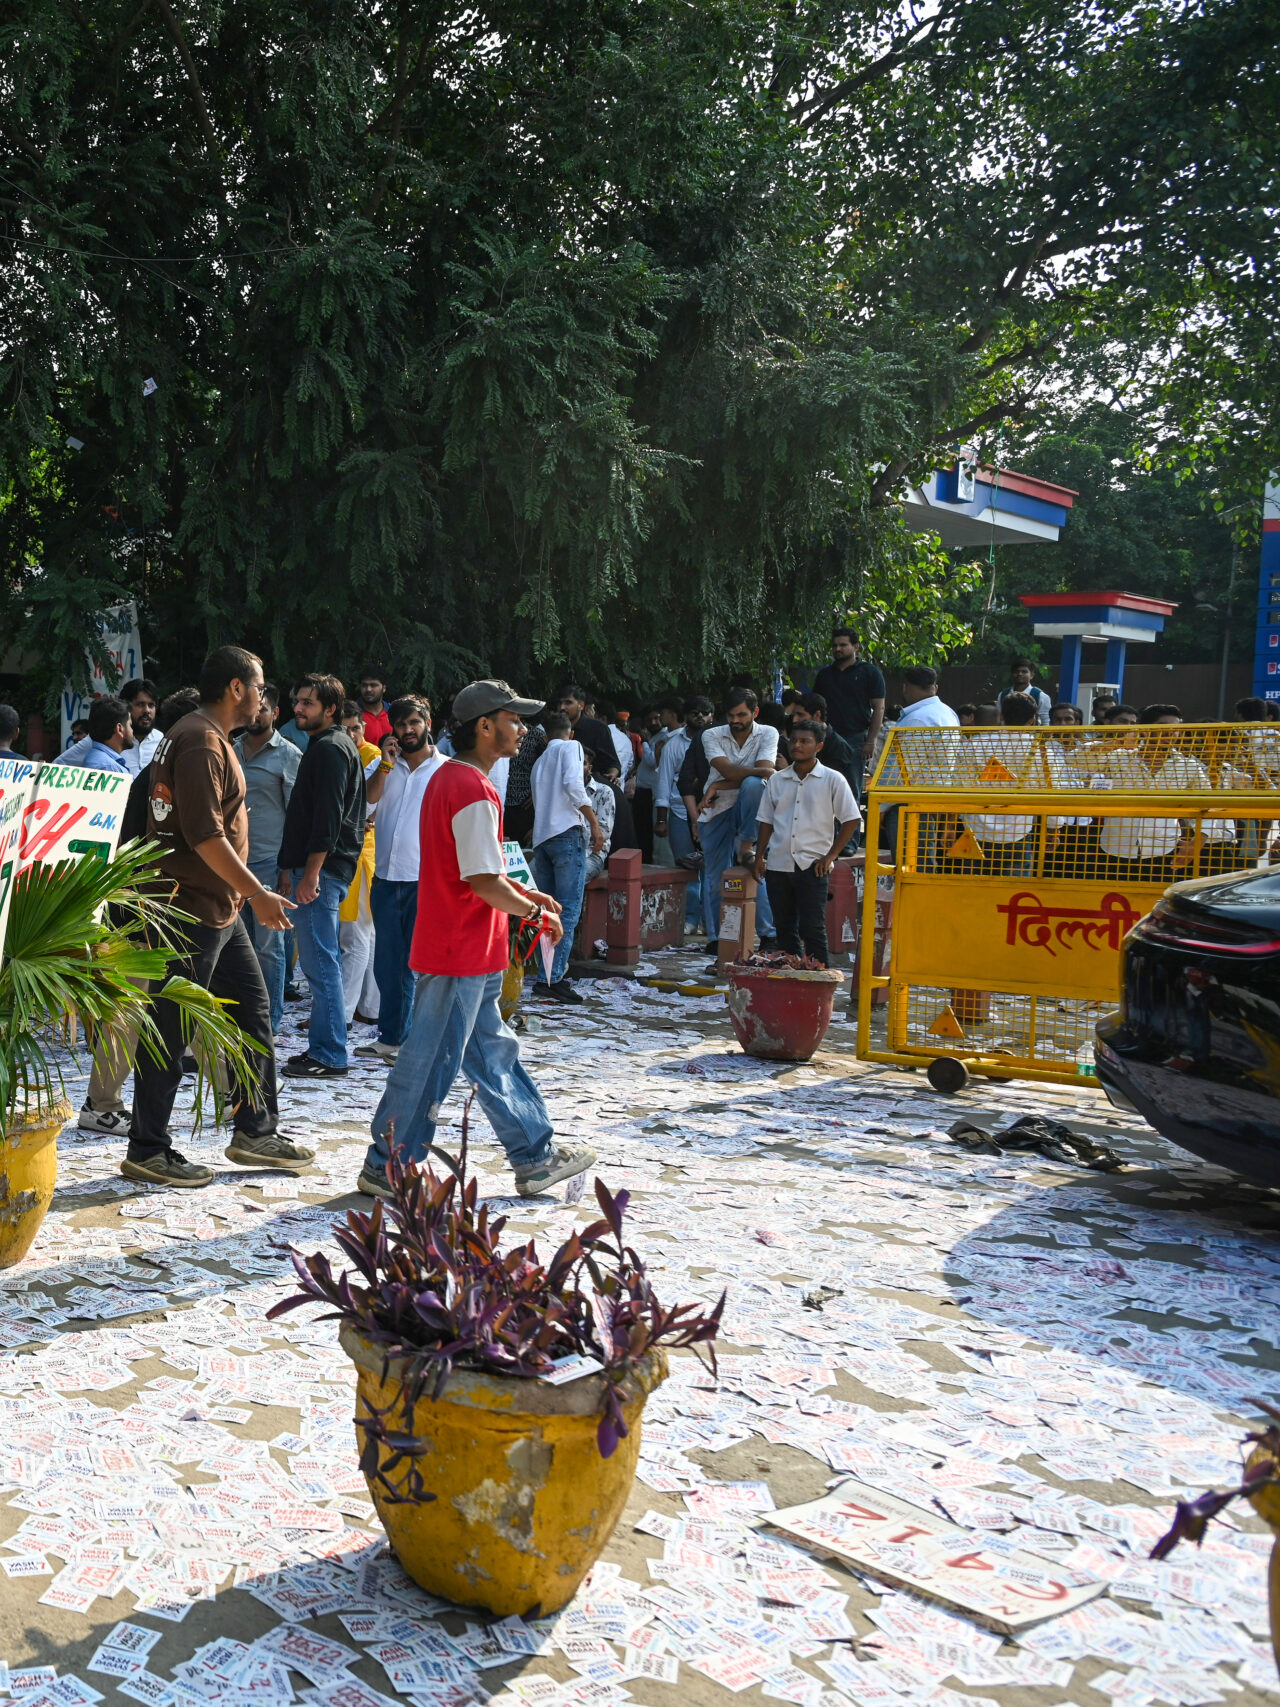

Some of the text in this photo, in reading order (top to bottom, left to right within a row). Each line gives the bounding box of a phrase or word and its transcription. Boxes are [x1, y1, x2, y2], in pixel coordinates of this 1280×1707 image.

[89, 811, 116, 831] B.N.
[997, 892, 1141, 957] दिल्ली
[317, 1650, 342, 1666] 2
